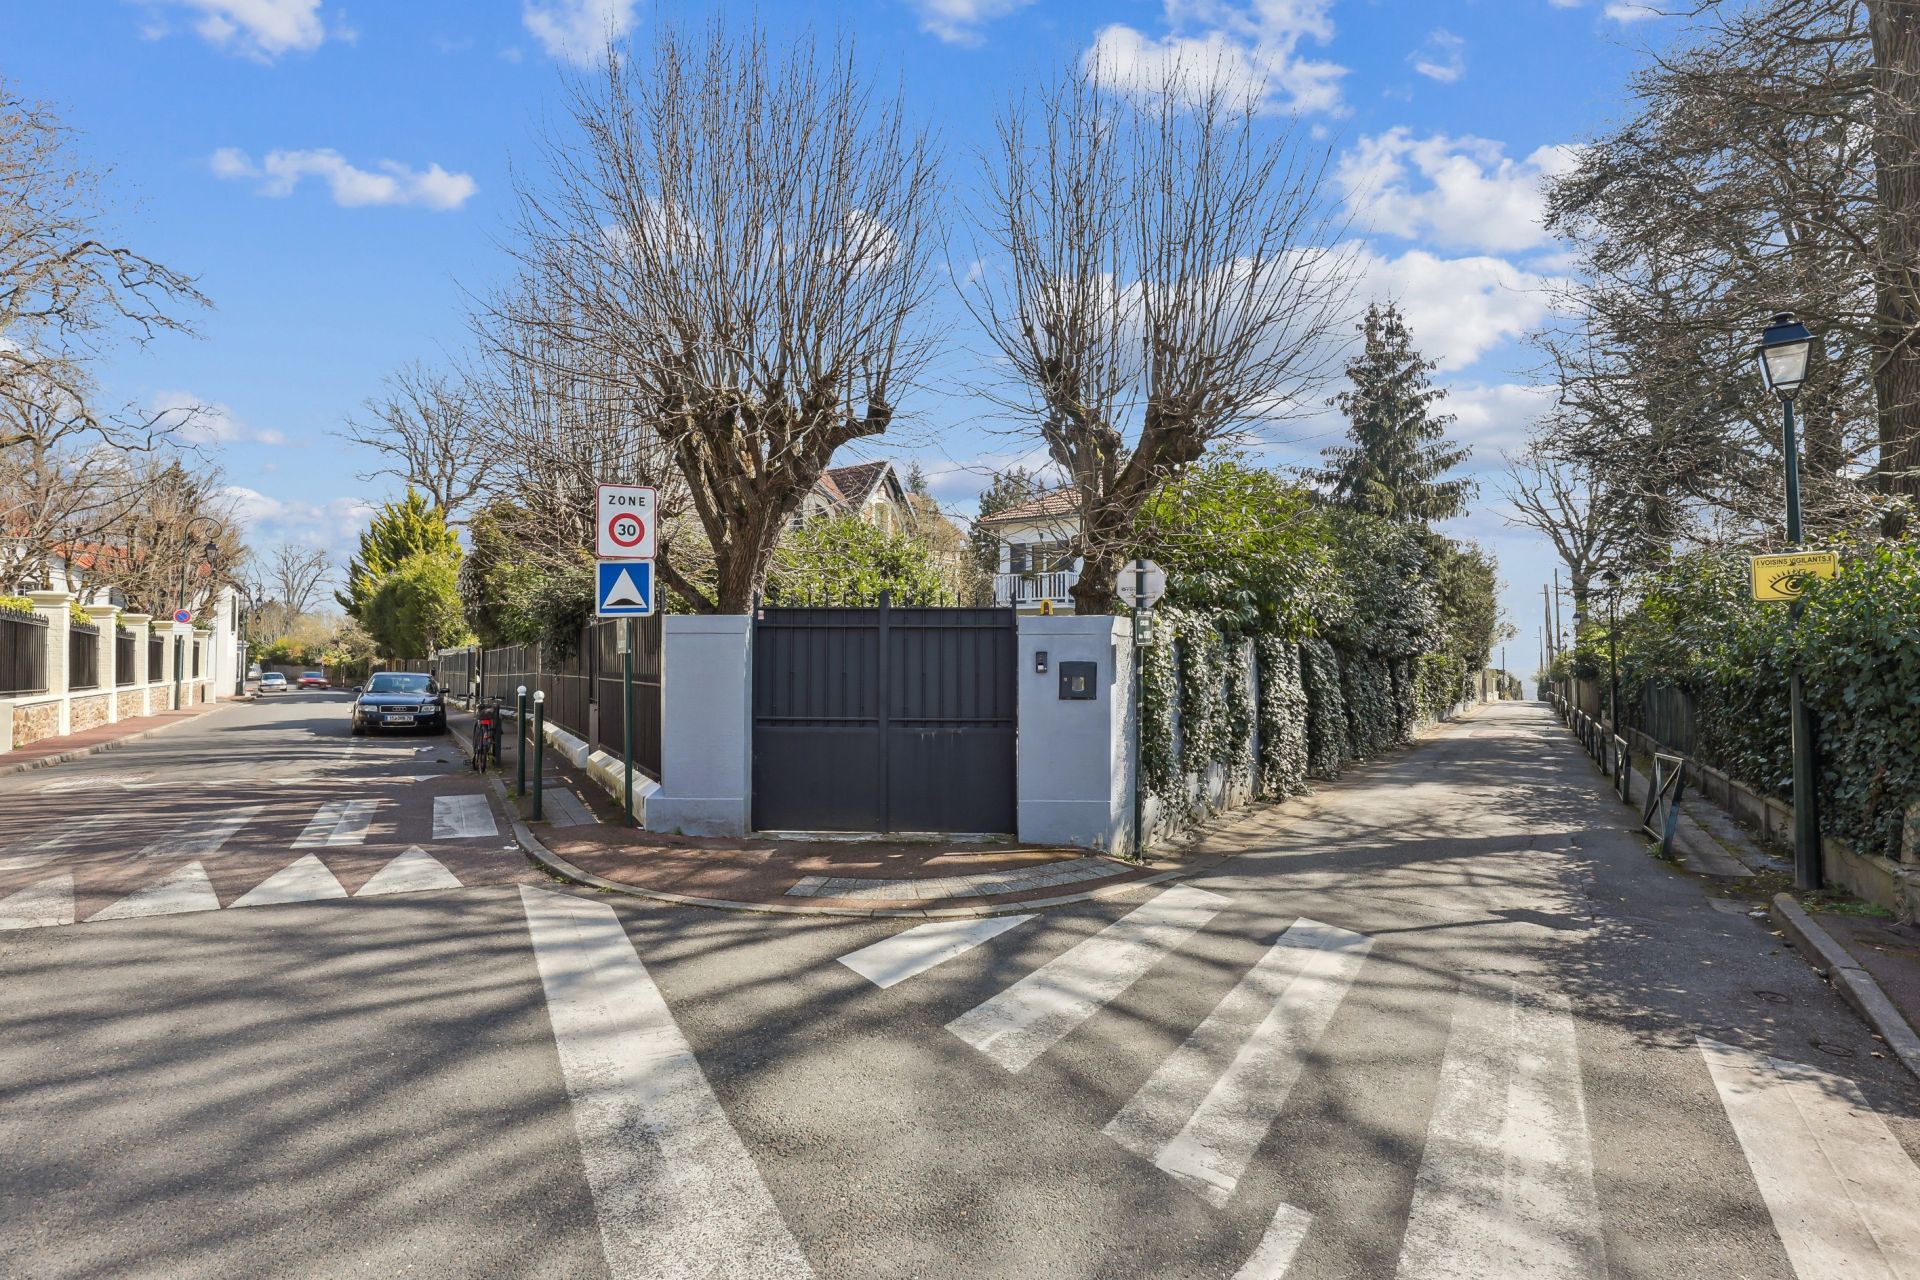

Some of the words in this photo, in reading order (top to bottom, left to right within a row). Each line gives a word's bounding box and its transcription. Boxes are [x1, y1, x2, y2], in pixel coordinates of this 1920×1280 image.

[608, 495, 646, 507] ZONE
[618, 524, 637, 536] 30
[1760, 558, 1788, 566] VOISINS
